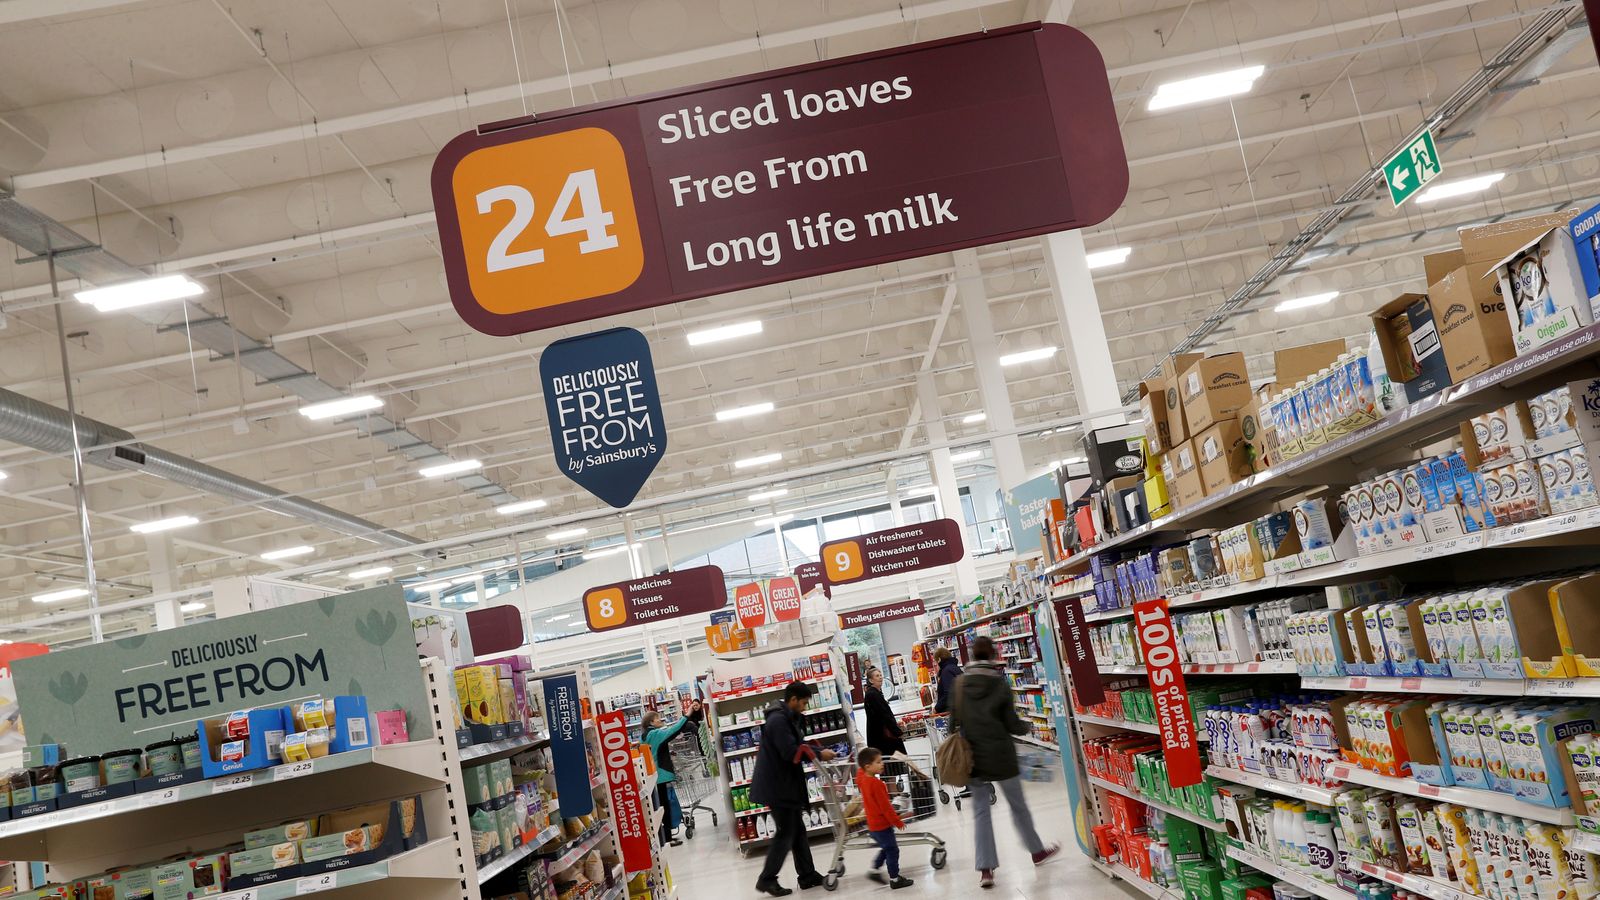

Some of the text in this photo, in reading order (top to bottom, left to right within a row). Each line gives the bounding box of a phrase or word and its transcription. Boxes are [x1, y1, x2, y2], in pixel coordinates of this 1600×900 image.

[658, 75, 913, 144] Sliced loaves
[669, 147, 869, 207] Free From
[475, 168, 619, 273] 24
[1574, 216, 1594, 237] GOOD
[683, 192, 958, 271] Long life milk
[1536, 315, 1569, 340] Original
[1475, 377, 1489, 388] This
[1489, 368, 1507, 382] shelf
[1507, 366, 1513, 376] is
[1513, 361, 1525, 374] for
[1523, 347, 1559, 369] colleague
[1560, 340, 1574, 353] use
[553, 360, 639, 395] DELICIOUSLY
[556, 381, 648, 427] FREE
[562, 412, 654, 455] FROM
[569, 442, 657, 474] by Sainsbury's
[1406, 485, 1418, 494] koko
[1019, 497, 1048, 516] Easter
[866, 528, 924, 546] Air fresheners
[1400, 531, 1415, 542] Light
[868, 538, 947, 560] Dishwasher tablets
[835, 551, 851, 572] 9
[871, 557, 920, 573] Kitchen roll
[629, 577, 672, 592] Medicines
[772, 587, 796, 600] GREAT
[599, 598, 614, 618] 8
[632, 594, 663, 606] Tissues
[738, 592, 760, 607] GREAT
[773, 600, 799, 612] PRICES
[634, 604, 679, 620] Toilet rolls
[739, 604, 764, 618] PRICES
[846, 604, 920, 624] Trolley self checkout
[1065, 604, 1086, 662] Long life milk
[172, 634, 258, 668] DELICIOUSLY
[1169, 685, 1184, 701] of
[1157, 690, 1179, 750] lowered
[1171, 704, 1190, 749] prices
[1558, 723, 1593, 738] alpro
[222, 762, 244, 772] Genius
[293, 763, 312, 772] £2.25
[232, 775, 251, 785] £2.25
[163, 790, 173, 798] £3
[624, 784, 634, 799] of
[613, 789, 633, 838] lowered
[624, 799, 642, 838] prices
[321, 876, 330, 885] £2
